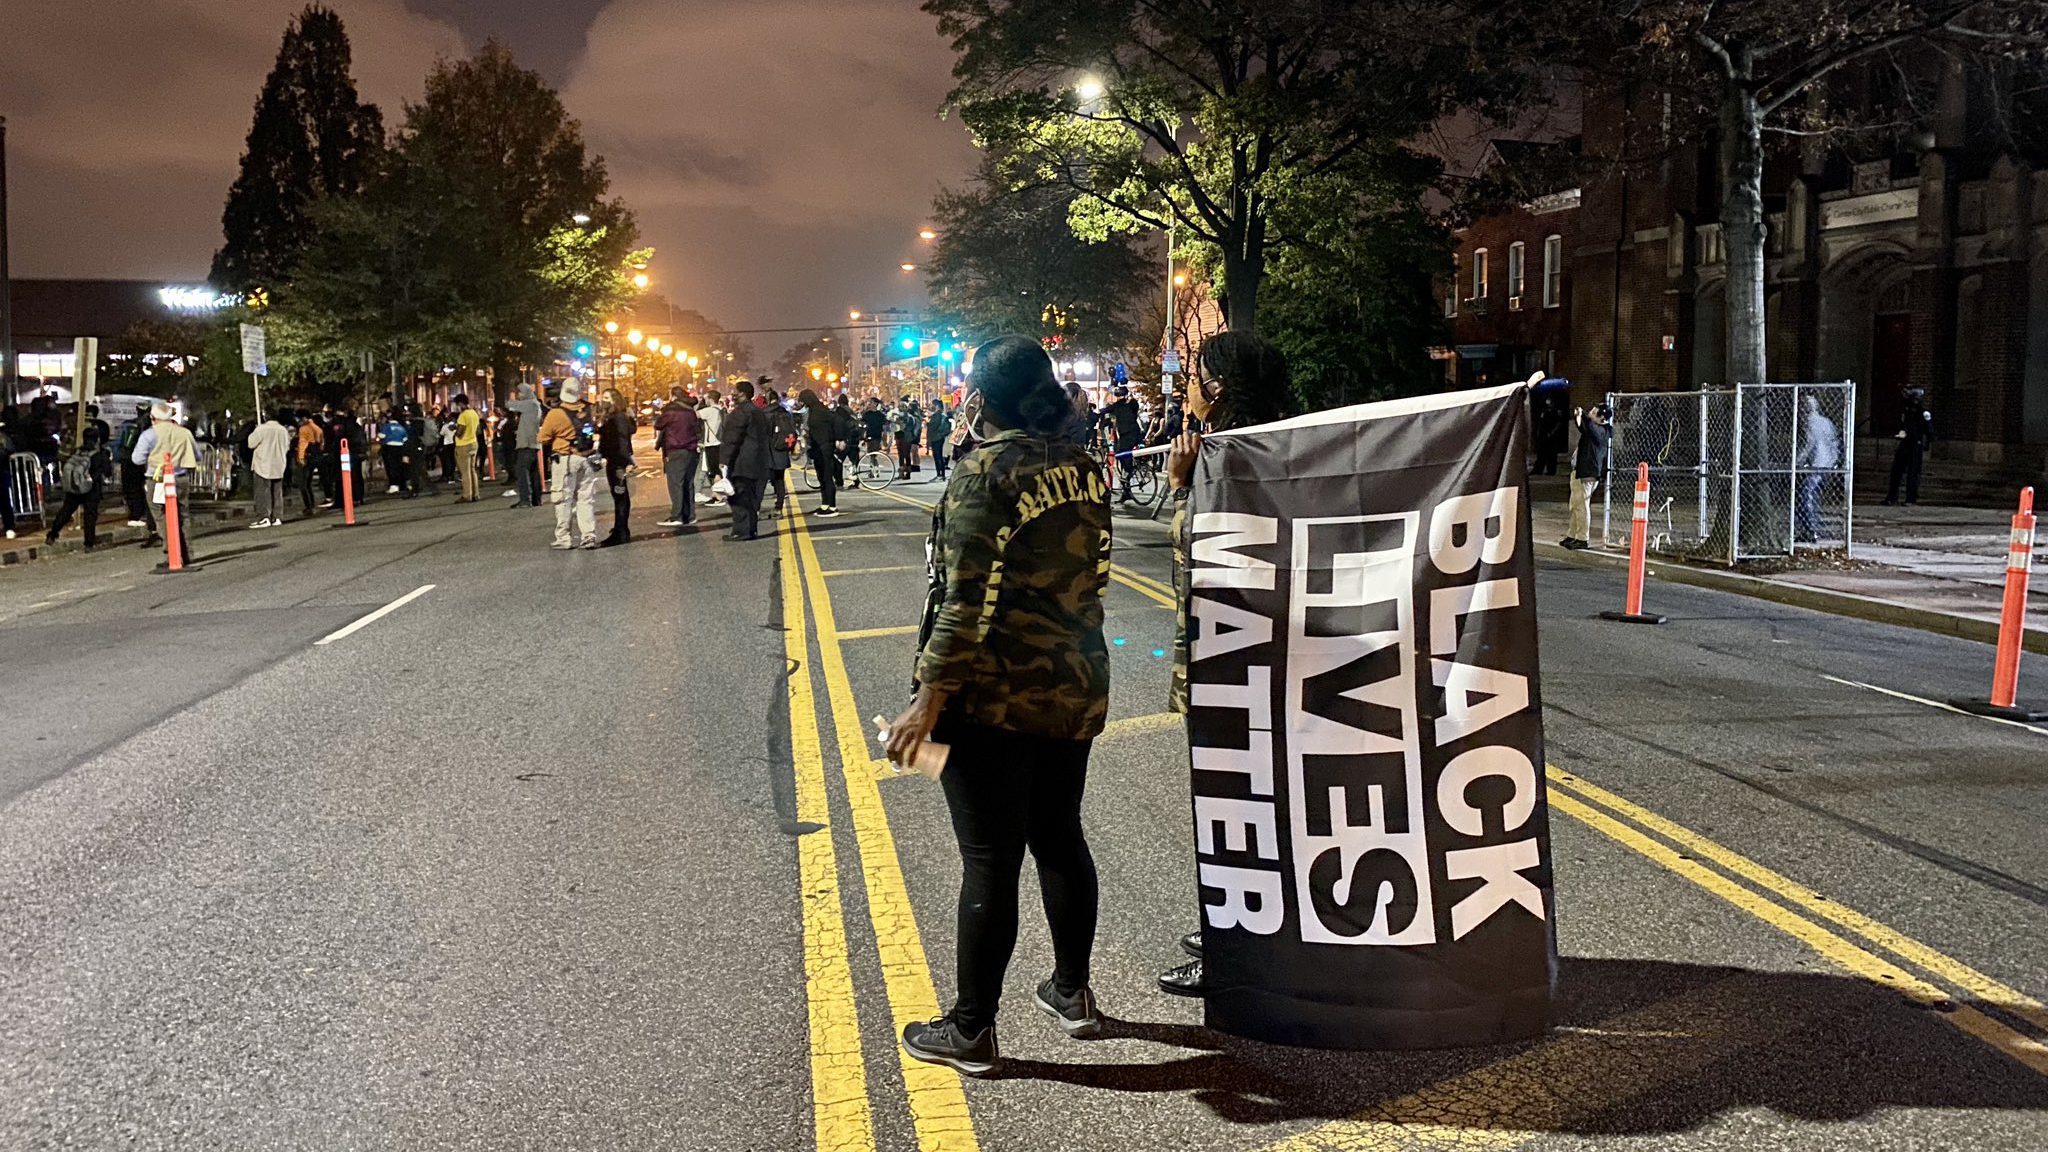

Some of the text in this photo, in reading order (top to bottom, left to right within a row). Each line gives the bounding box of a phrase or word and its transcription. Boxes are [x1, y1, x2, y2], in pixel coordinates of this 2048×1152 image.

[1189, 512, 1285, 936] MATTER
[1301, 516, 1419, 938] LIVES
[1428, 486, 1546, 942] BLACK
